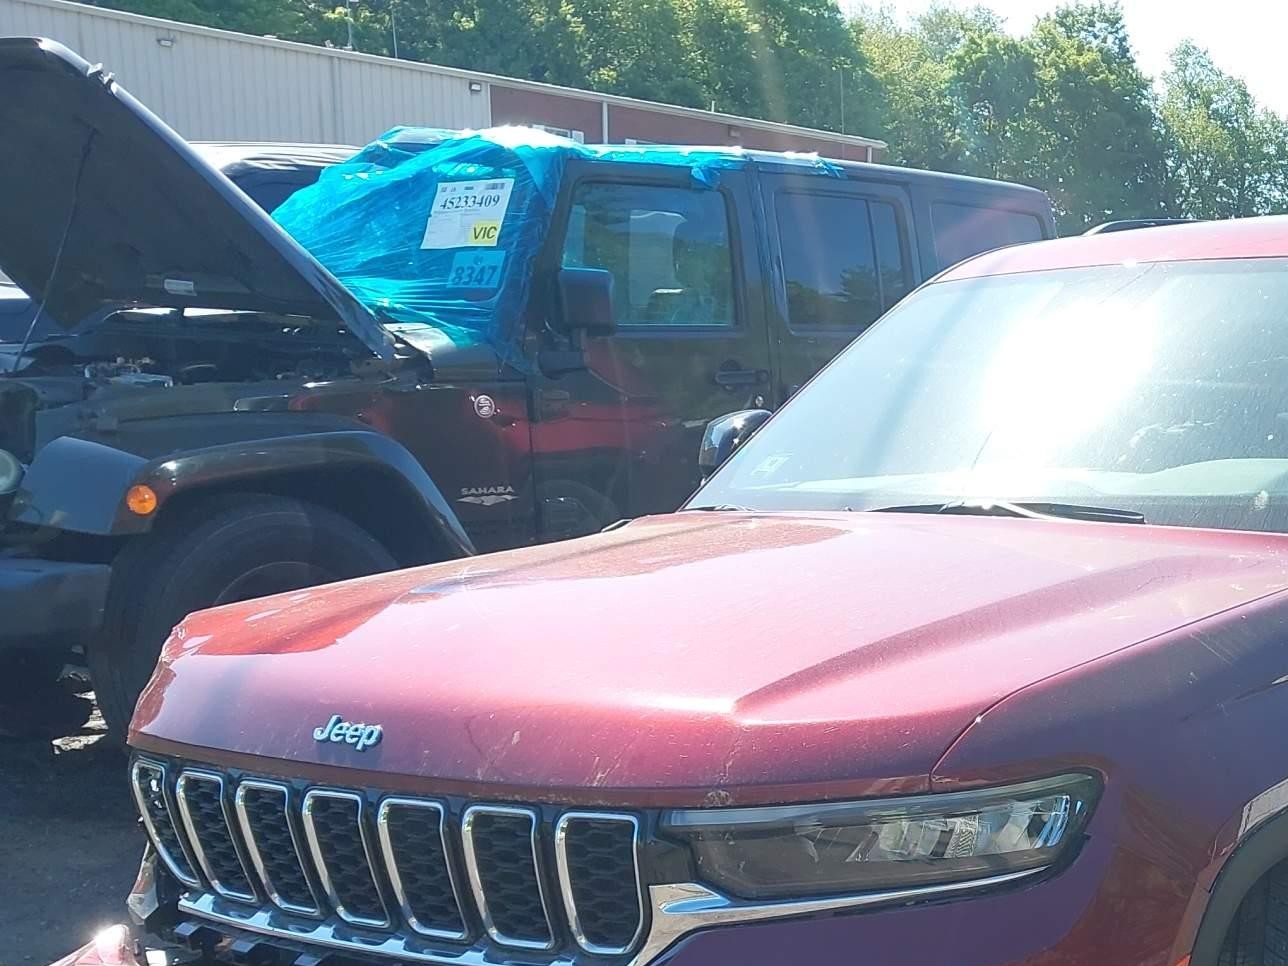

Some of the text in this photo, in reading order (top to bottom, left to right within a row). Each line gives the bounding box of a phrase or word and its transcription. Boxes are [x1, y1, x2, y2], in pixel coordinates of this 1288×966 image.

[440, 194, 500, 210] 45233409
[473, 226, 498, 241] VIC
[452, 265, 498, 286] 8347
[460, 485, 515, 496] SAHARA
[312, 713, 384, 752] Jeep
